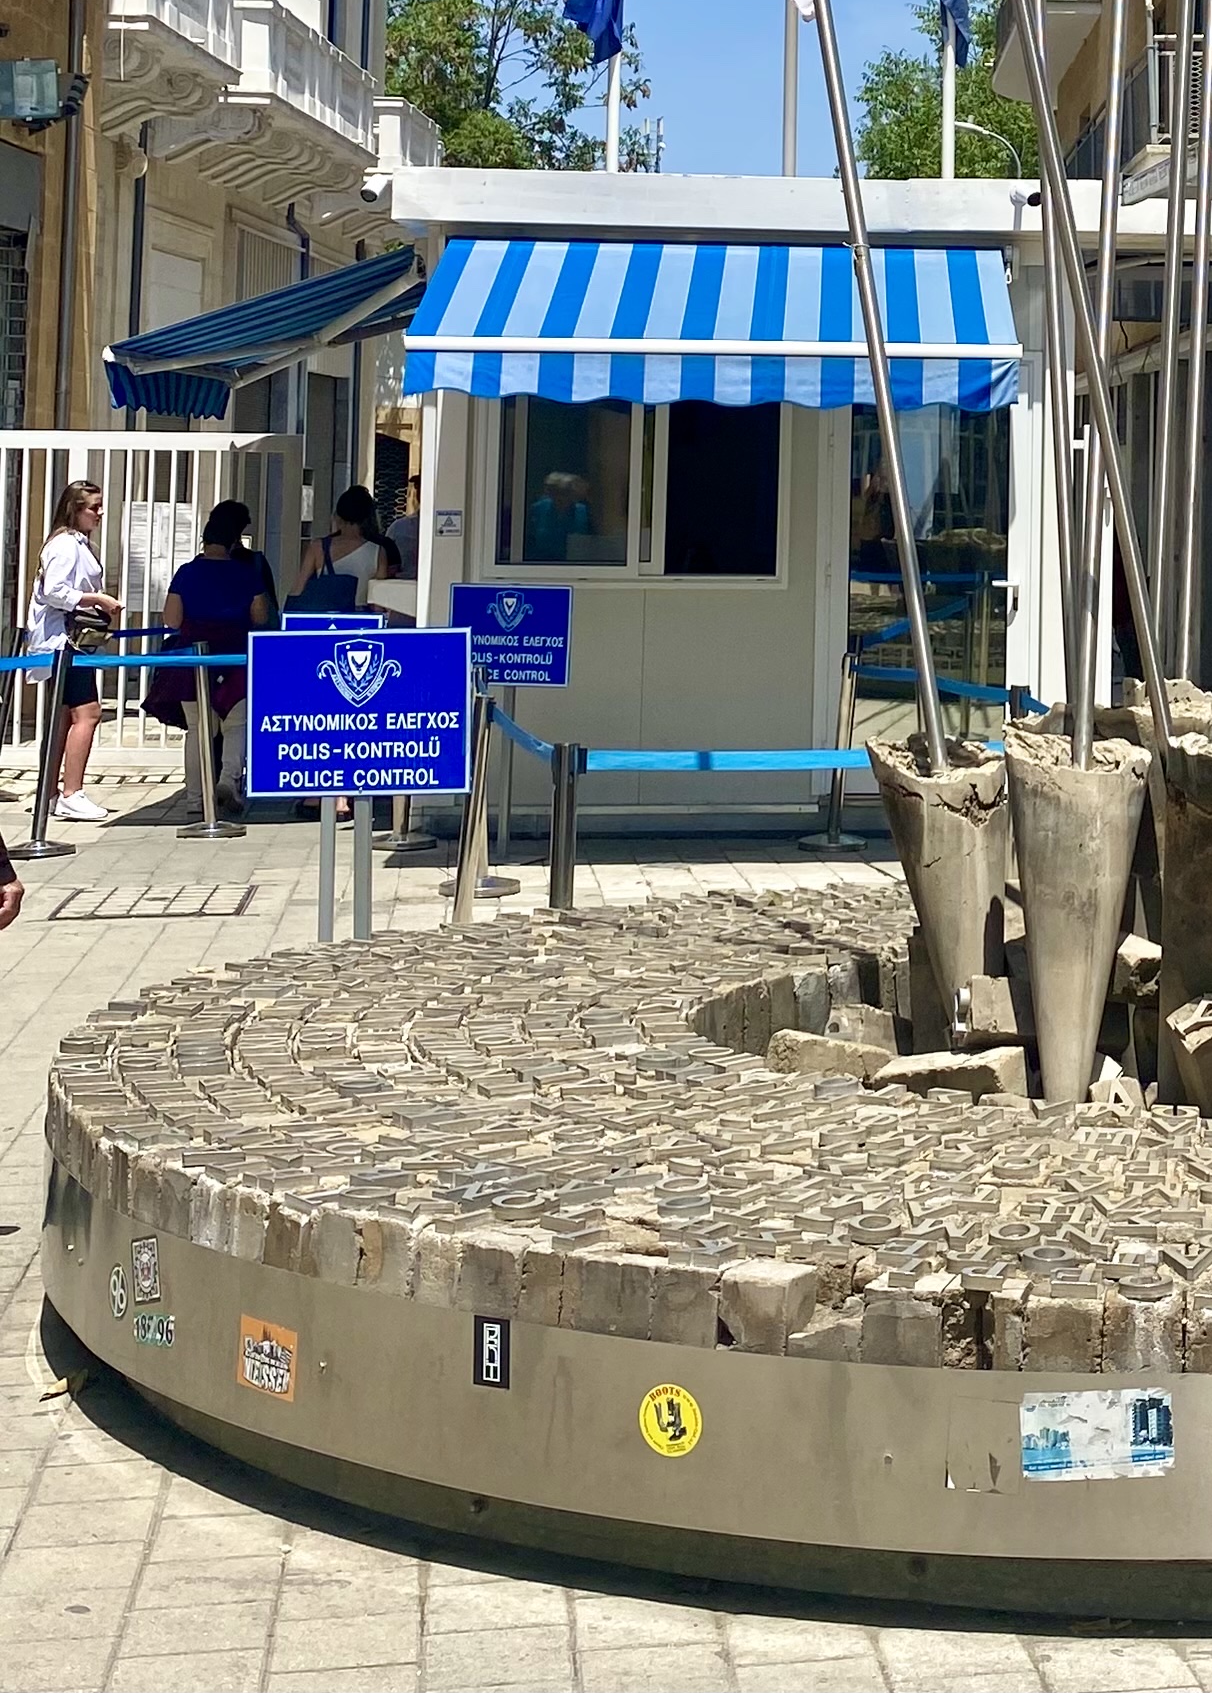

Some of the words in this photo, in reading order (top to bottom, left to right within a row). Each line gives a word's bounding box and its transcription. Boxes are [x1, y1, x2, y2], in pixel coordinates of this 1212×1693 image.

[473, 635, 519, 646] ΥΝΟΜΙΚΟΣ
[523, 636, 564, 647] ΕΛΕΓΧΟΣ
[472, 652, 553, 664] OLIS-KONTROLÜ
[504, 669, 551, 681] CONTROL
[261, 713, 378, 732] ΑΣΤΥΝΟΜΙΚΟΣ
[386, 712, 460, 730] ΕΛΕΓΧΟΣ
[279, 770, 344, 788] POLICE
[353, 768, 439, 787] CONTROL
[648, 1385, 682, 1403] BOOTS
